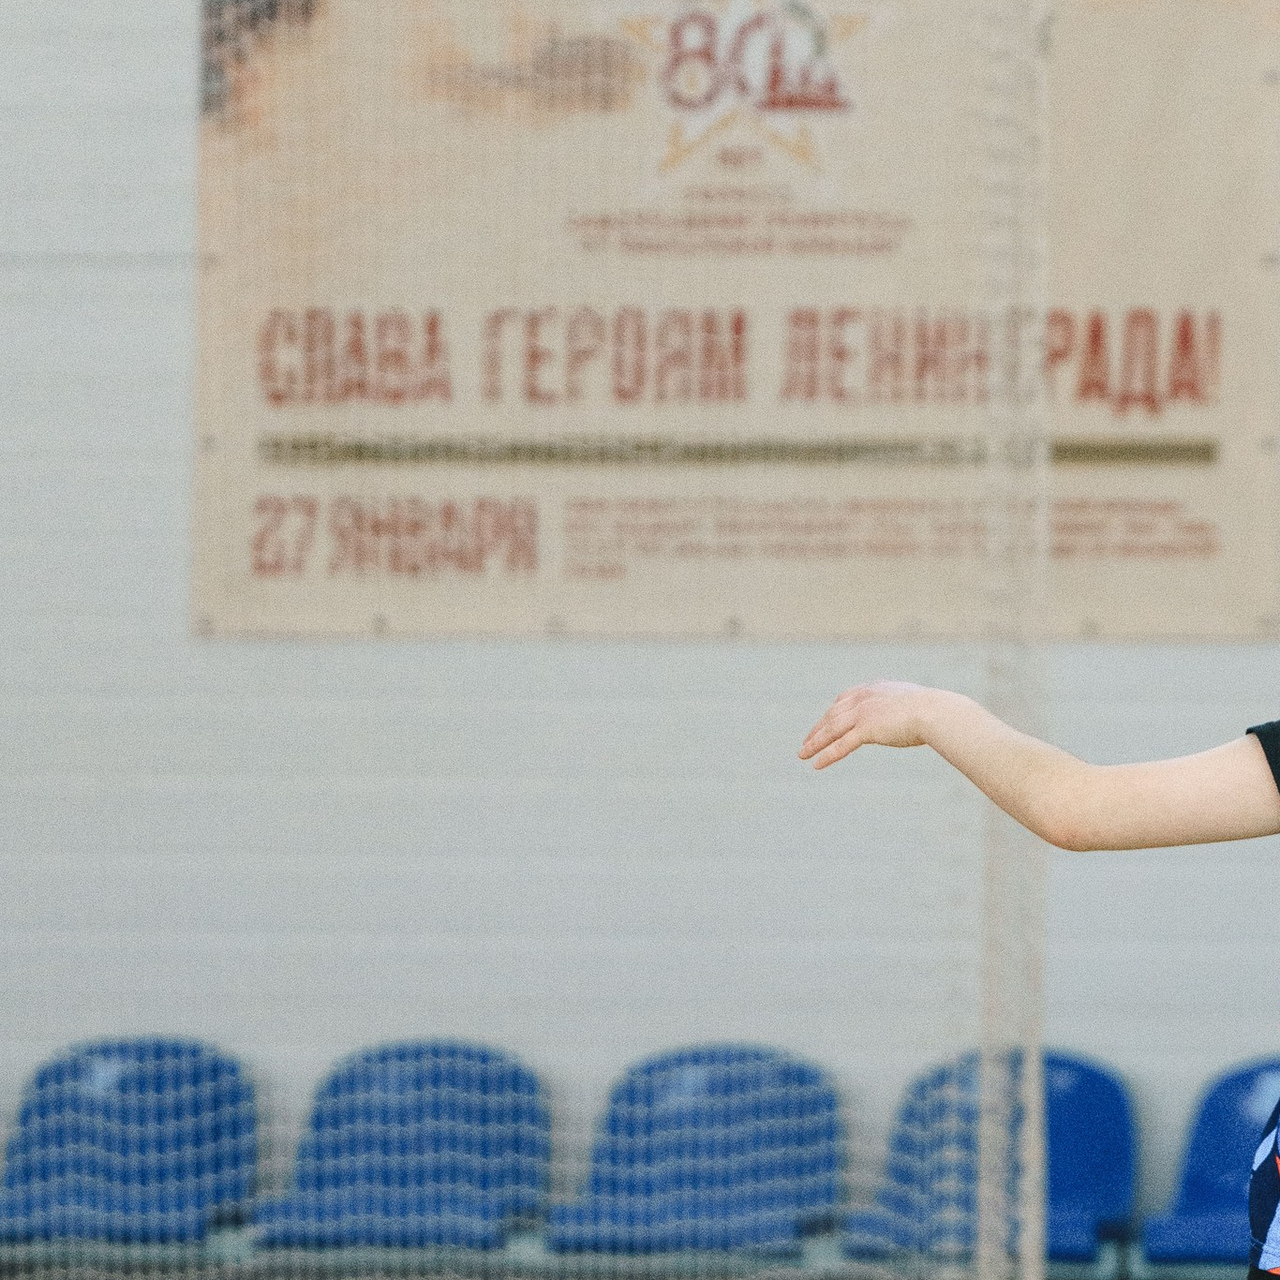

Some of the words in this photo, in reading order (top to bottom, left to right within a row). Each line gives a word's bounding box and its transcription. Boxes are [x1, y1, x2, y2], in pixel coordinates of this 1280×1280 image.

[256, 307, 452, 407] СЛАВА
[481, 307, 748, 405] ГЕРОЯМ
[252, 495, 319, 577] 27
[328, 496, 539, 577] ЯНВАРЯ
